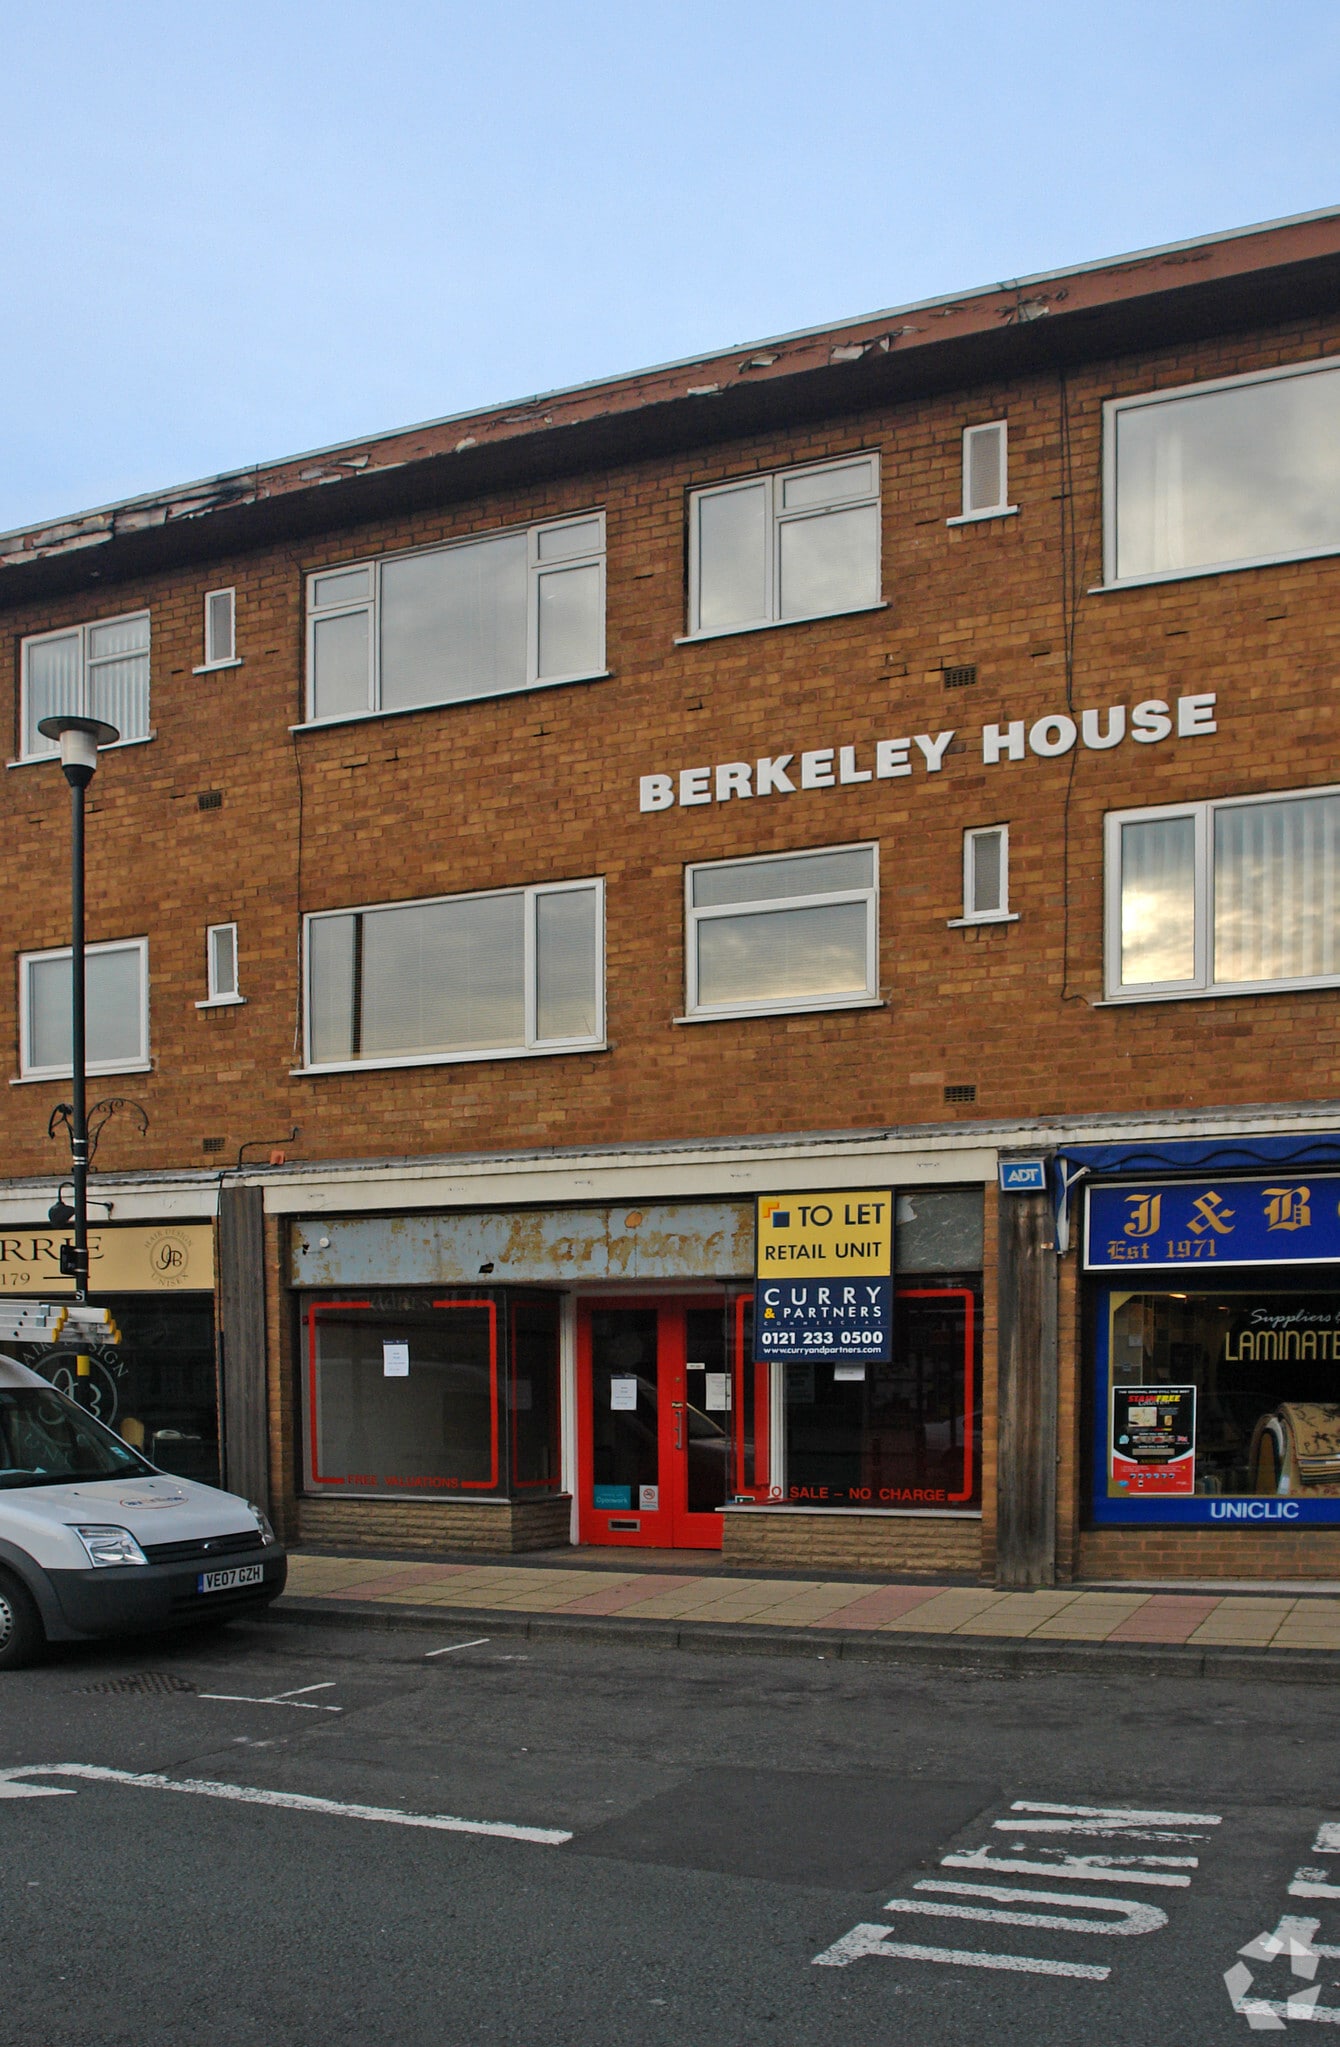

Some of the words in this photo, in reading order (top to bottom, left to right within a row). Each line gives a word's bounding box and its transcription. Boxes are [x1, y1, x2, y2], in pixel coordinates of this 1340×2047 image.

[640, 731, 955, 812] BERKELEY
[983, 693, 1217, 765] HOUSE
[1008, 1168, 1039, 1183] ADT
[798, 1205, 833, 1227] TO
[845, 1203, 885, 1225] LET
[1123, 1193, 1162, 1237] J
[1186, 1190, 1236, 1235] &
[1261, 1186, 1311, 1232] B
[765, 1244, 826, 1260] RETAIL
[835, 1242, 882, 1258] UNIT
[1107, 1240, 1149, 1261] Est
[1166, 1239, 1218, 1259] 1971
[764, 1286, 881, 1306] CURRY
[764, 1308, 775, 1319] &
[783, 1306, 882, 1319] PARTNERS
[1250, 1308, 1331, 1328] Suppliers
[762, 1332, 796, 1344] 0121
[802, 1332, 834, 1344] 233
[841, 1331, 883, 1343] 0500
[763, 1346, 882, 1355] www.curryandpartners.com
[347, 1474, 378, 1487] FREE
[384, 1475, 459, 1489] VALUATIONS
[790, 1486, 829, 1499] SALE
[849, 1488, 871, 1500] NO
[879, 1488, 946, 1501] CHARGE
[1210, 1502, 1299, 1518] UNICLIC
[207, 1570, 236, 1588] VE07
[238, 1566, 260, 1583] GZH
